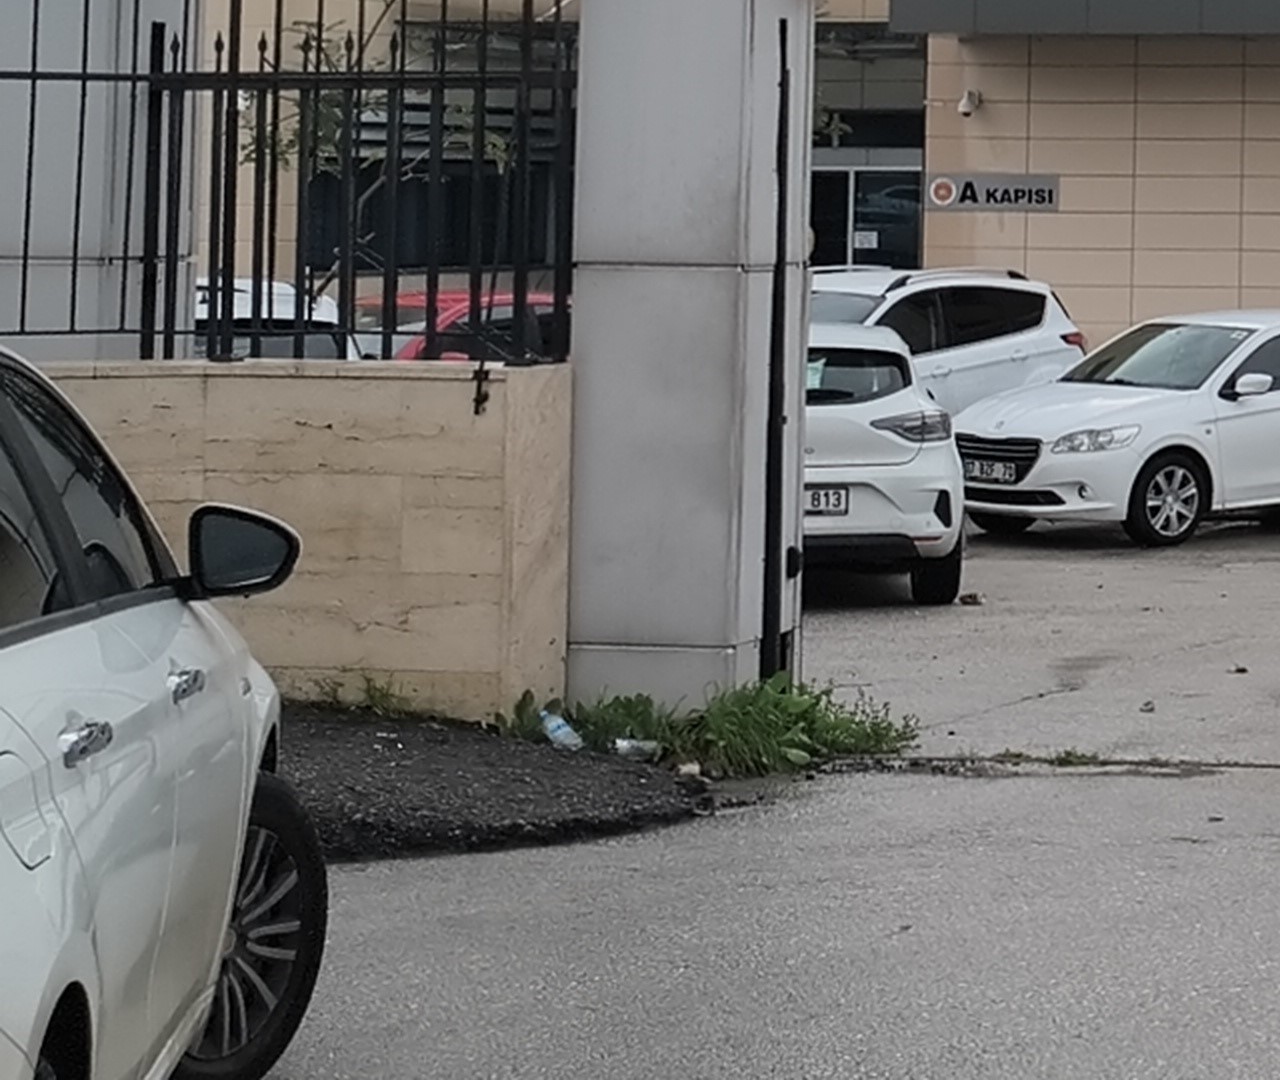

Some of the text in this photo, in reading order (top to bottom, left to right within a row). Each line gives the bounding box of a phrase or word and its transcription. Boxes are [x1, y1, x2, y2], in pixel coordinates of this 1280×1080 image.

[958, 181, 1053, 205] A KAPISI
[809, 490, 843, 509] 813
